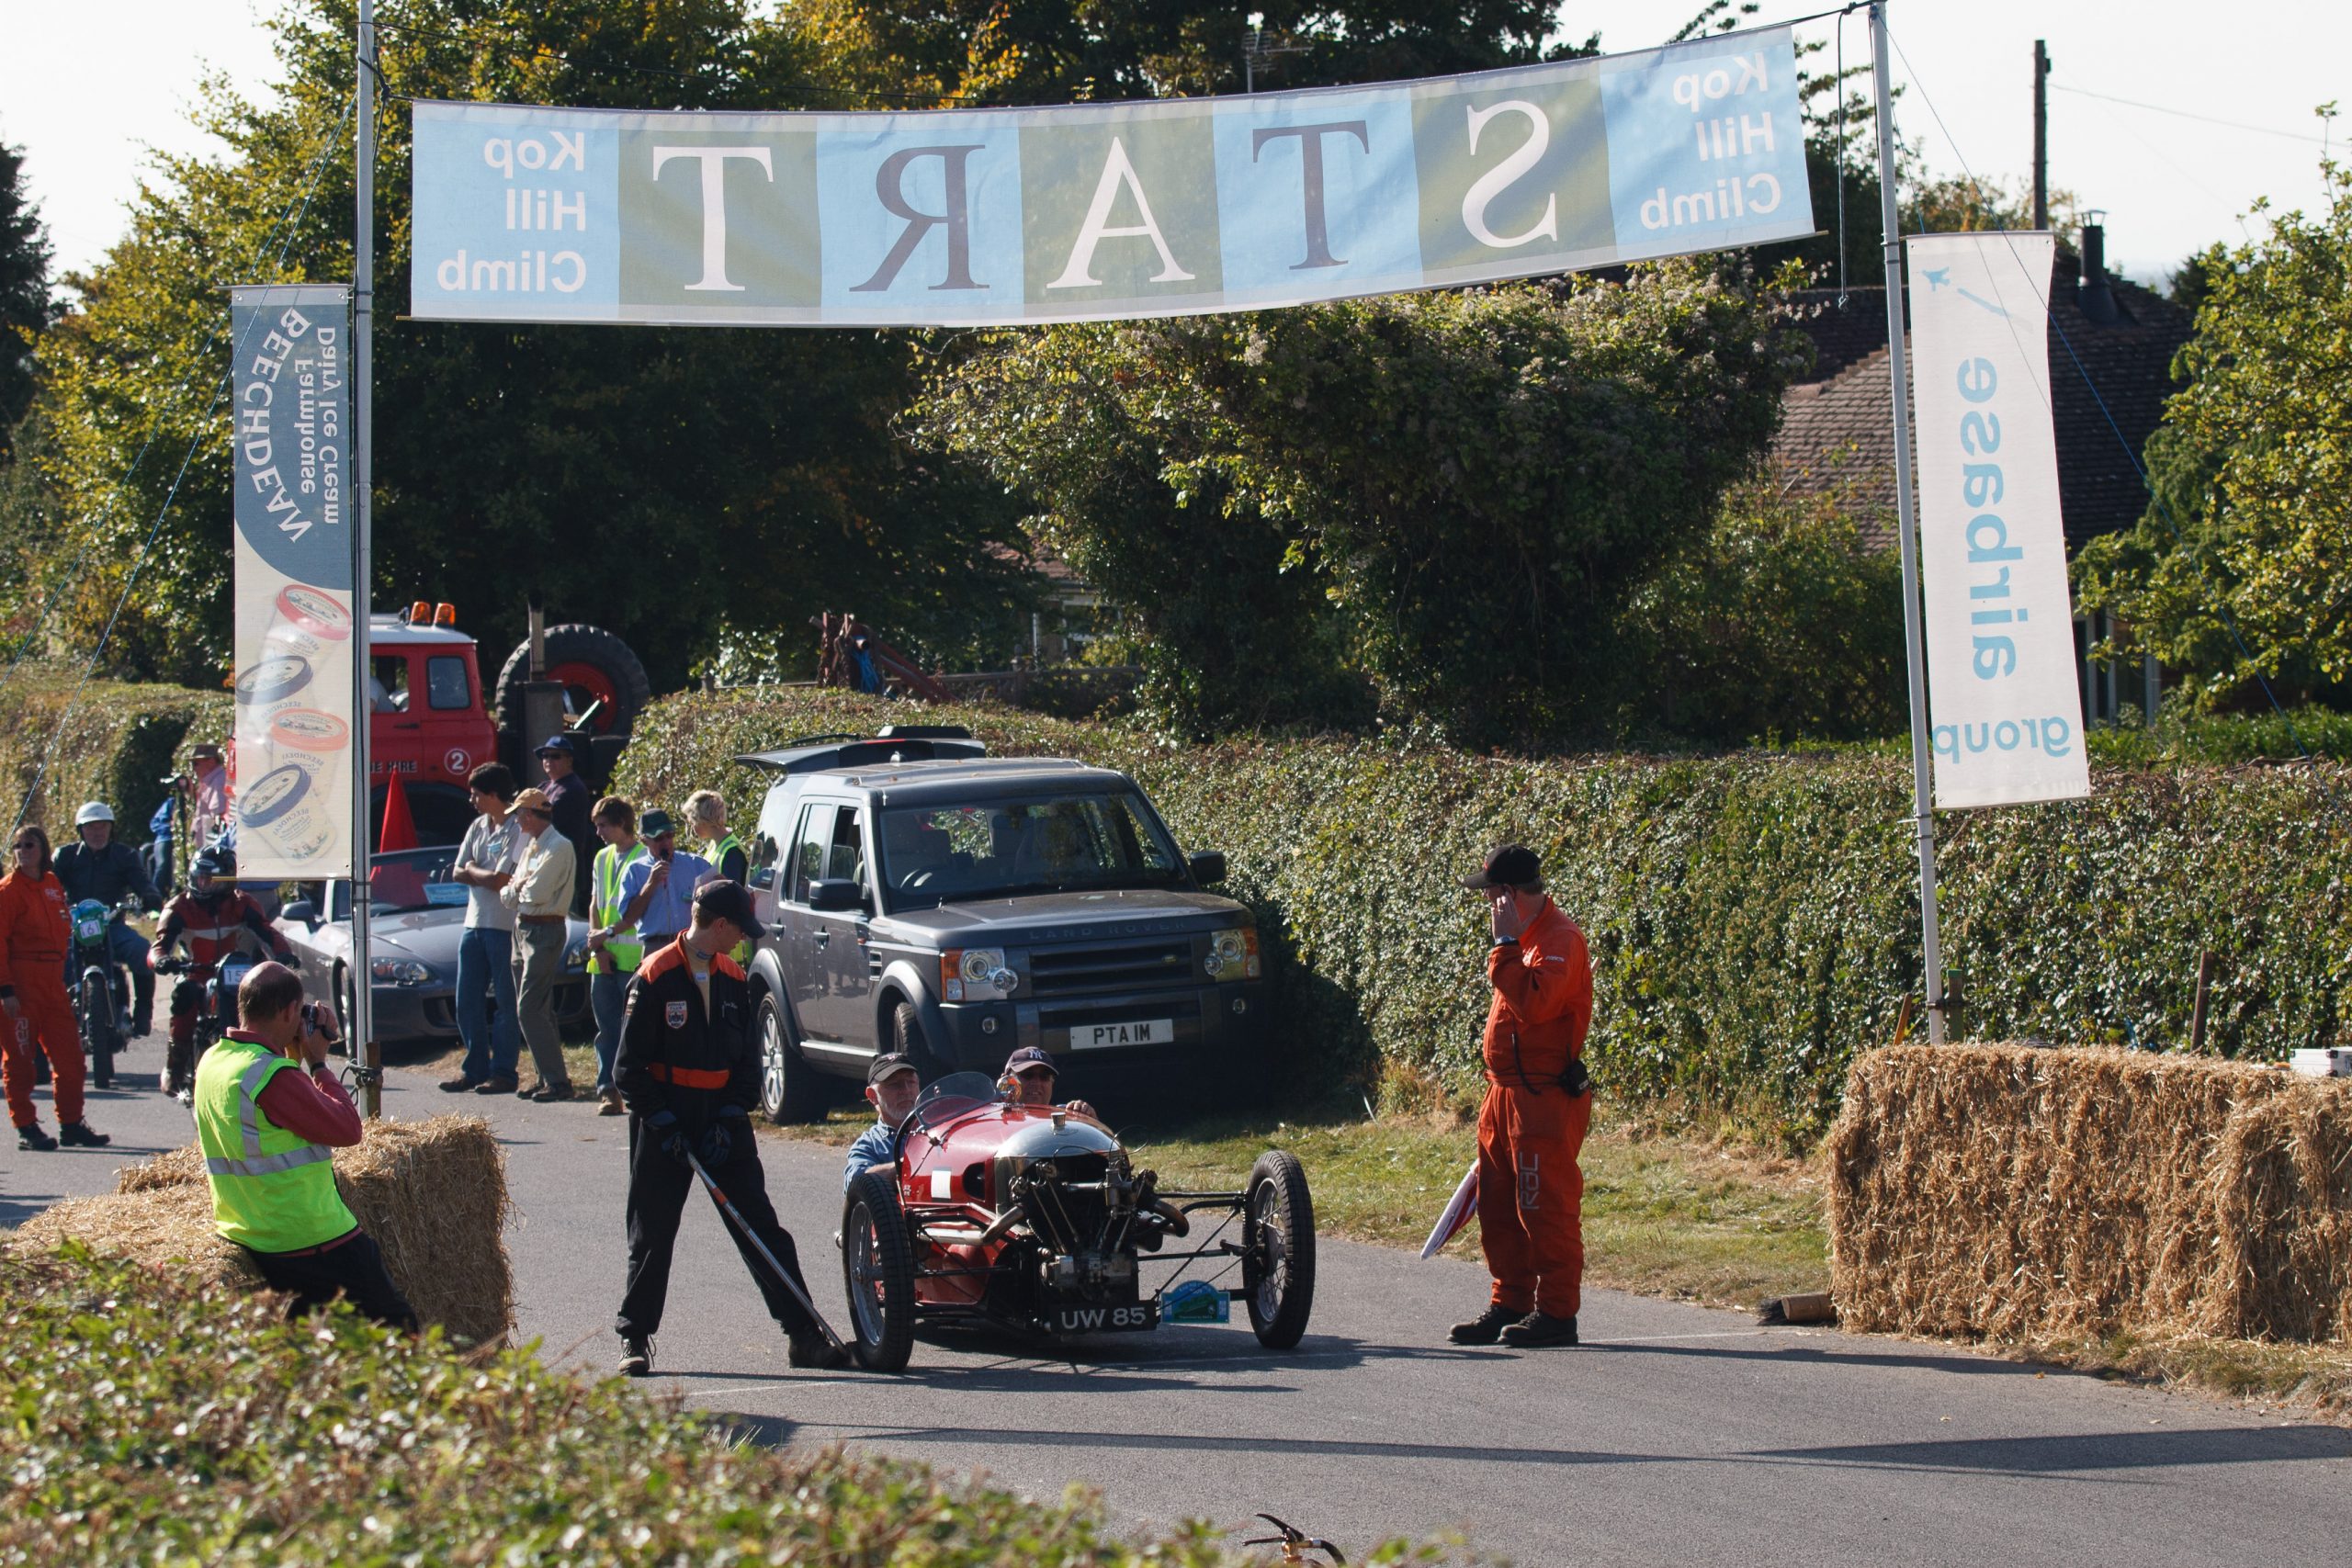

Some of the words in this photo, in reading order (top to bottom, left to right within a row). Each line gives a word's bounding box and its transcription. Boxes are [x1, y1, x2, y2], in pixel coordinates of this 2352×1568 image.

[451, 751, 464, 771] 2
[1029, 928, 1092, 940] LAND
[1108, 922, 1185, 934] ROVER
[1061, 1308, 1106, 1330] UW
[1113, 1306, 1147, 1325] 85
